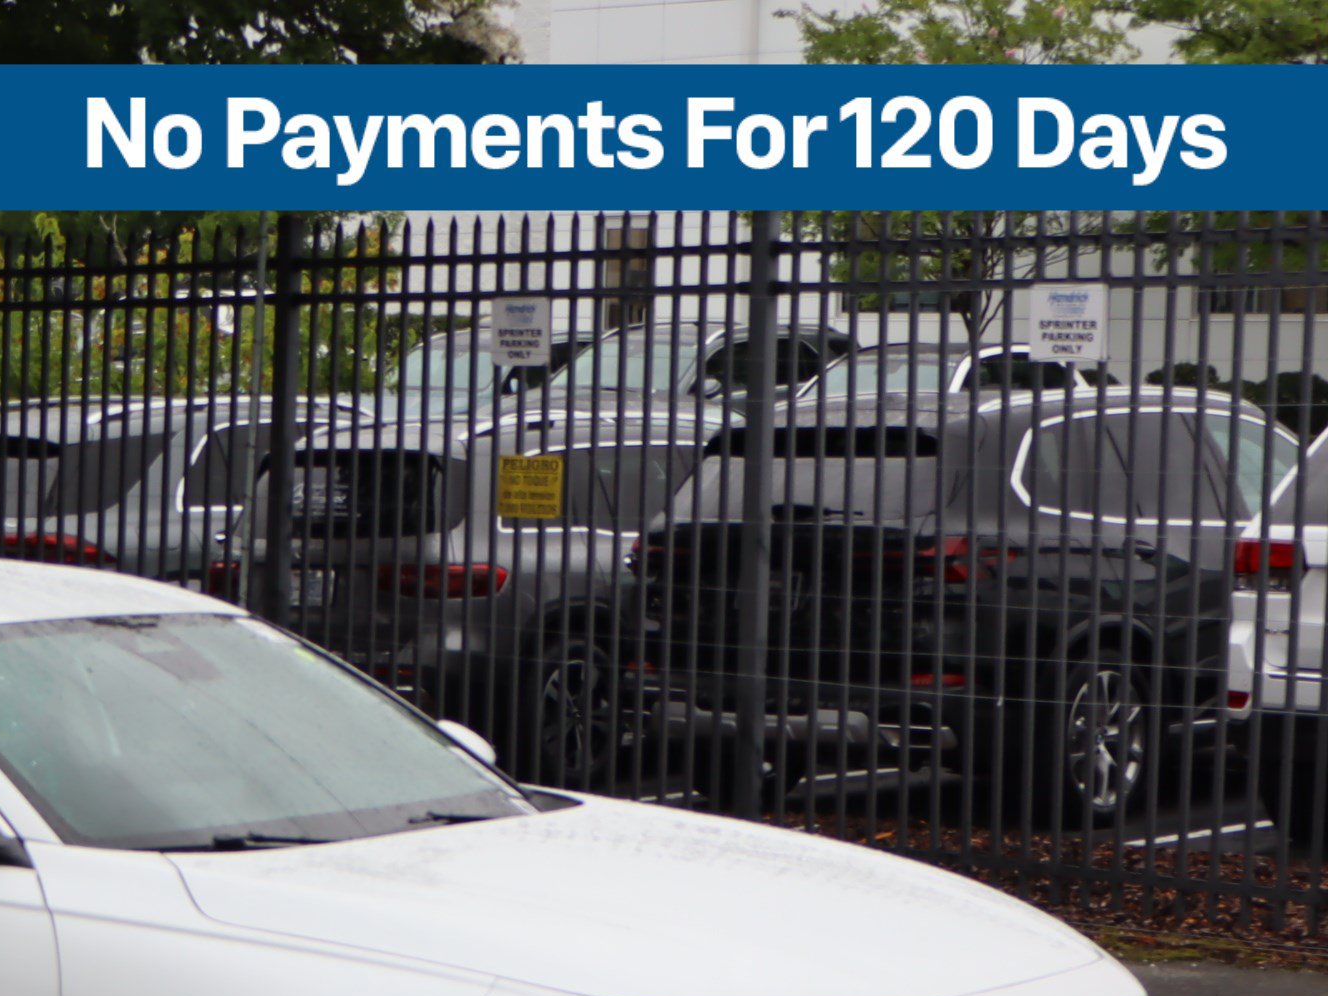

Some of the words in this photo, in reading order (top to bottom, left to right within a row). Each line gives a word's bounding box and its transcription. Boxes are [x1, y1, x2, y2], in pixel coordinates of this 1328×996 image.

[1039, 320, 1097, 330] SPRINTER
[498, 329, 542, 338] SPRINTER
[1041, 332, 1094, 342] PARKING
[500, 339, 540, 348] PARKING
[1051, 344, 1083, 354] ONLY
[507, 350, 531, 359] ONLY
[502, 459, 559, 472] PELIGRO
